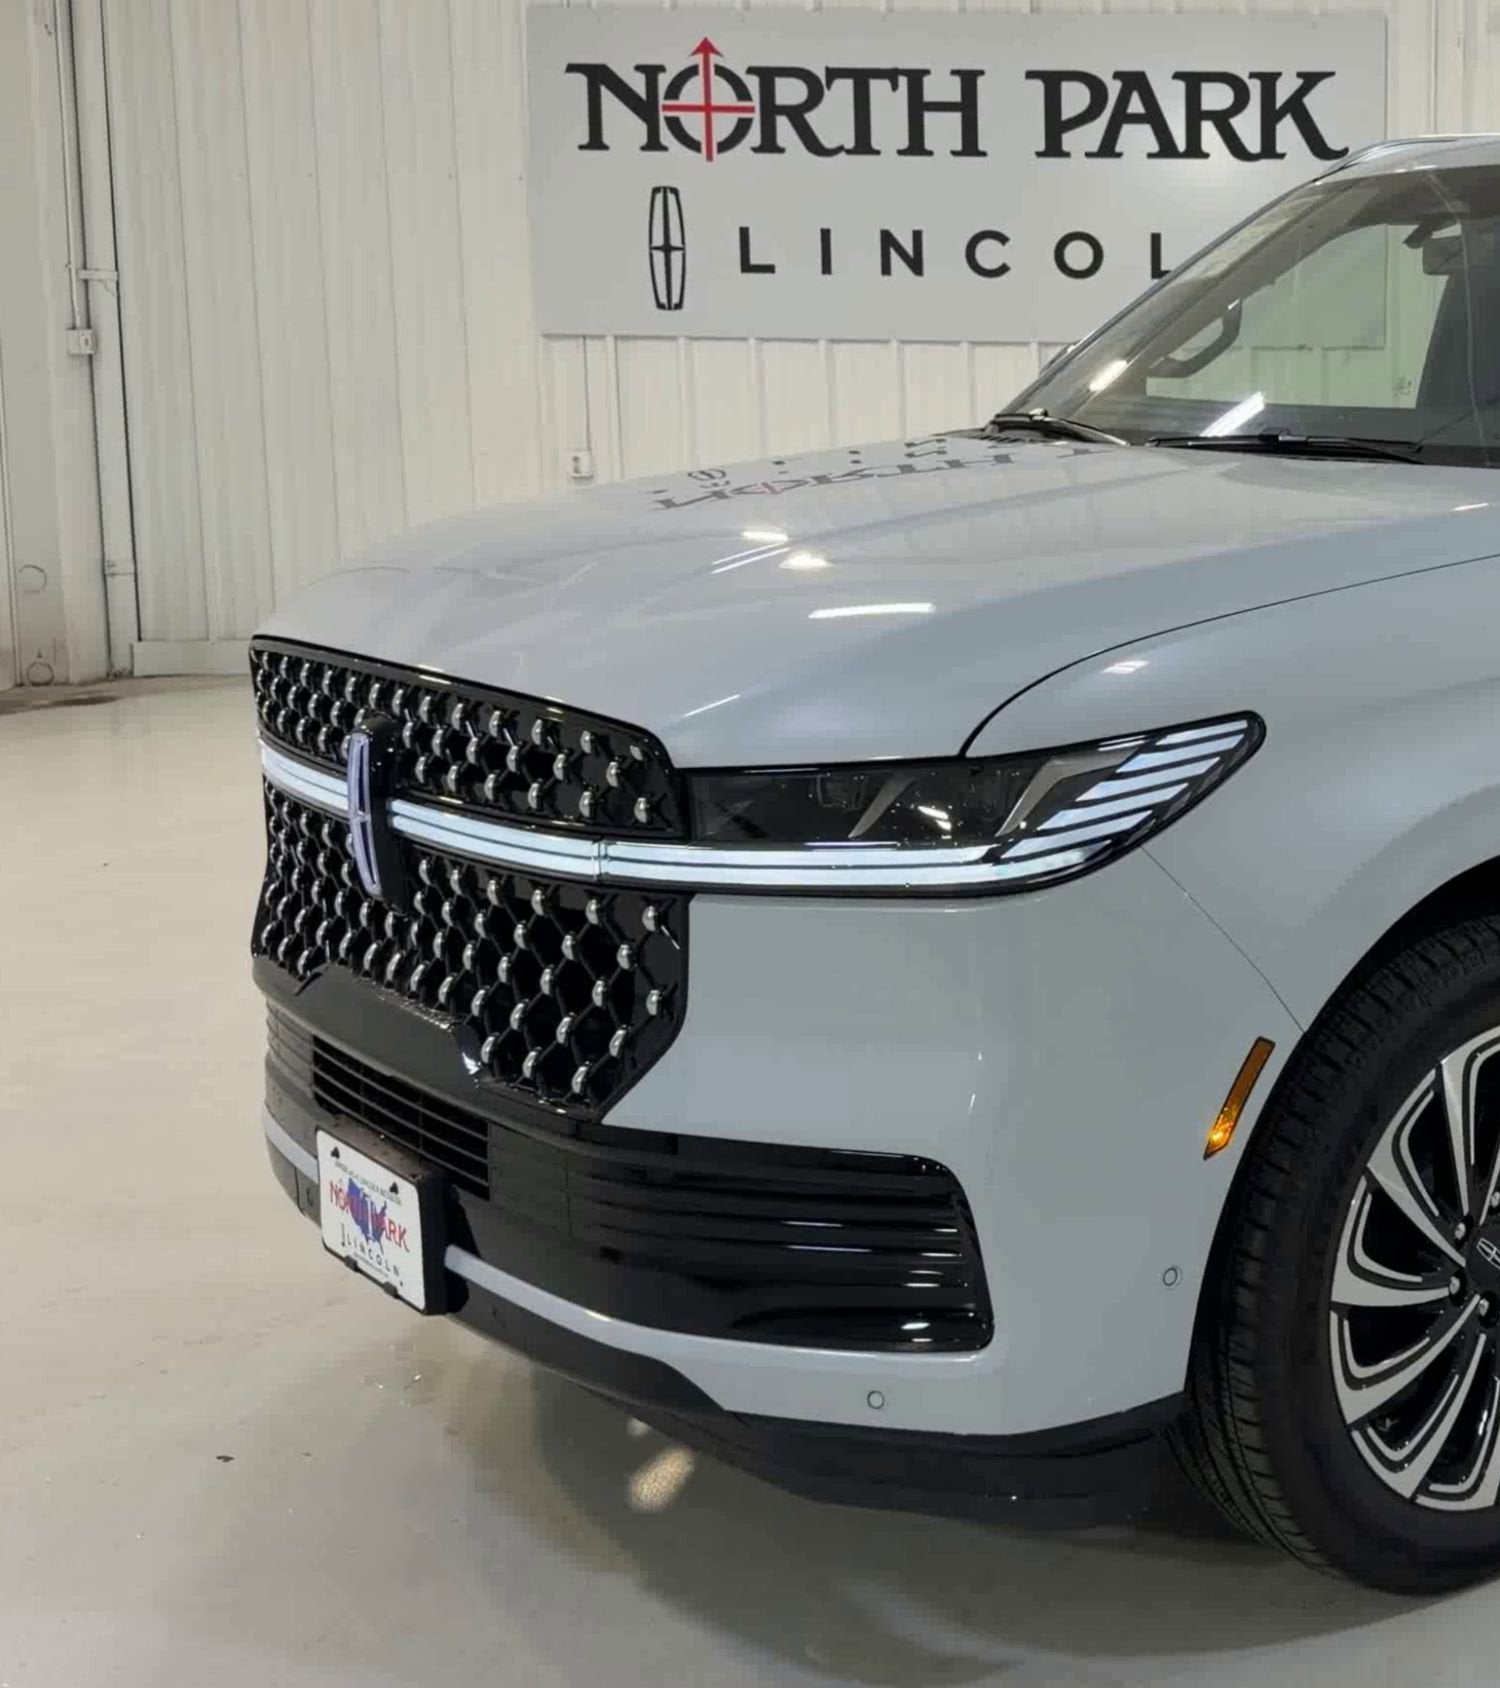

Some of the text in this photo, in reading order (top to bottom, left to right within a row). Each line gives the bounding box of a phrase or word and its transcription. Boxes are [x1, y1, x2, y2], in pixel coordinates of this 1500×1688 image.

[565, 62, 1350, 162] NORTH PARK
[738, 226, 1172, 281] LINCOL
[346, 1234, 401, 1277] LINCOLN
